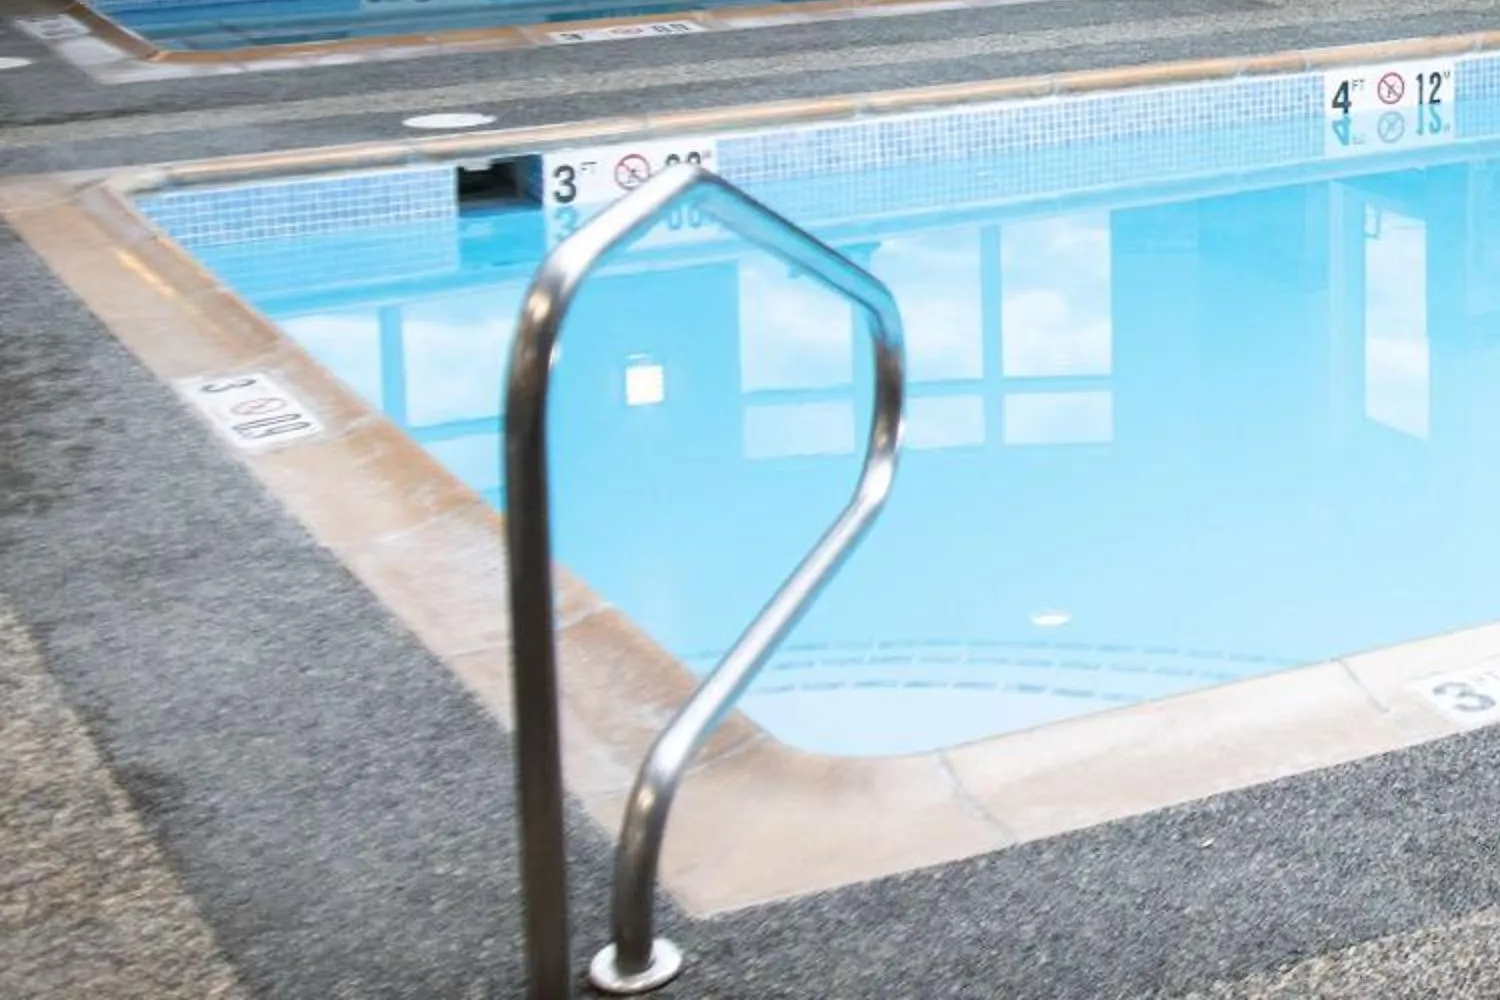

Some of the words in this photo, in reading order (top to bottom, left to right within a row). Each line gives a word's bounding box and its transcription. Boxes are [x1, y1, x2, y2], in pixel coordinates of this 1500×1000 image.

[1332, 80, 1352, 114] 4
[1416, 71, 1442, 105] 12
[553, 165, 577, 204] 3
[1432, 681, 1497, 713] 3
